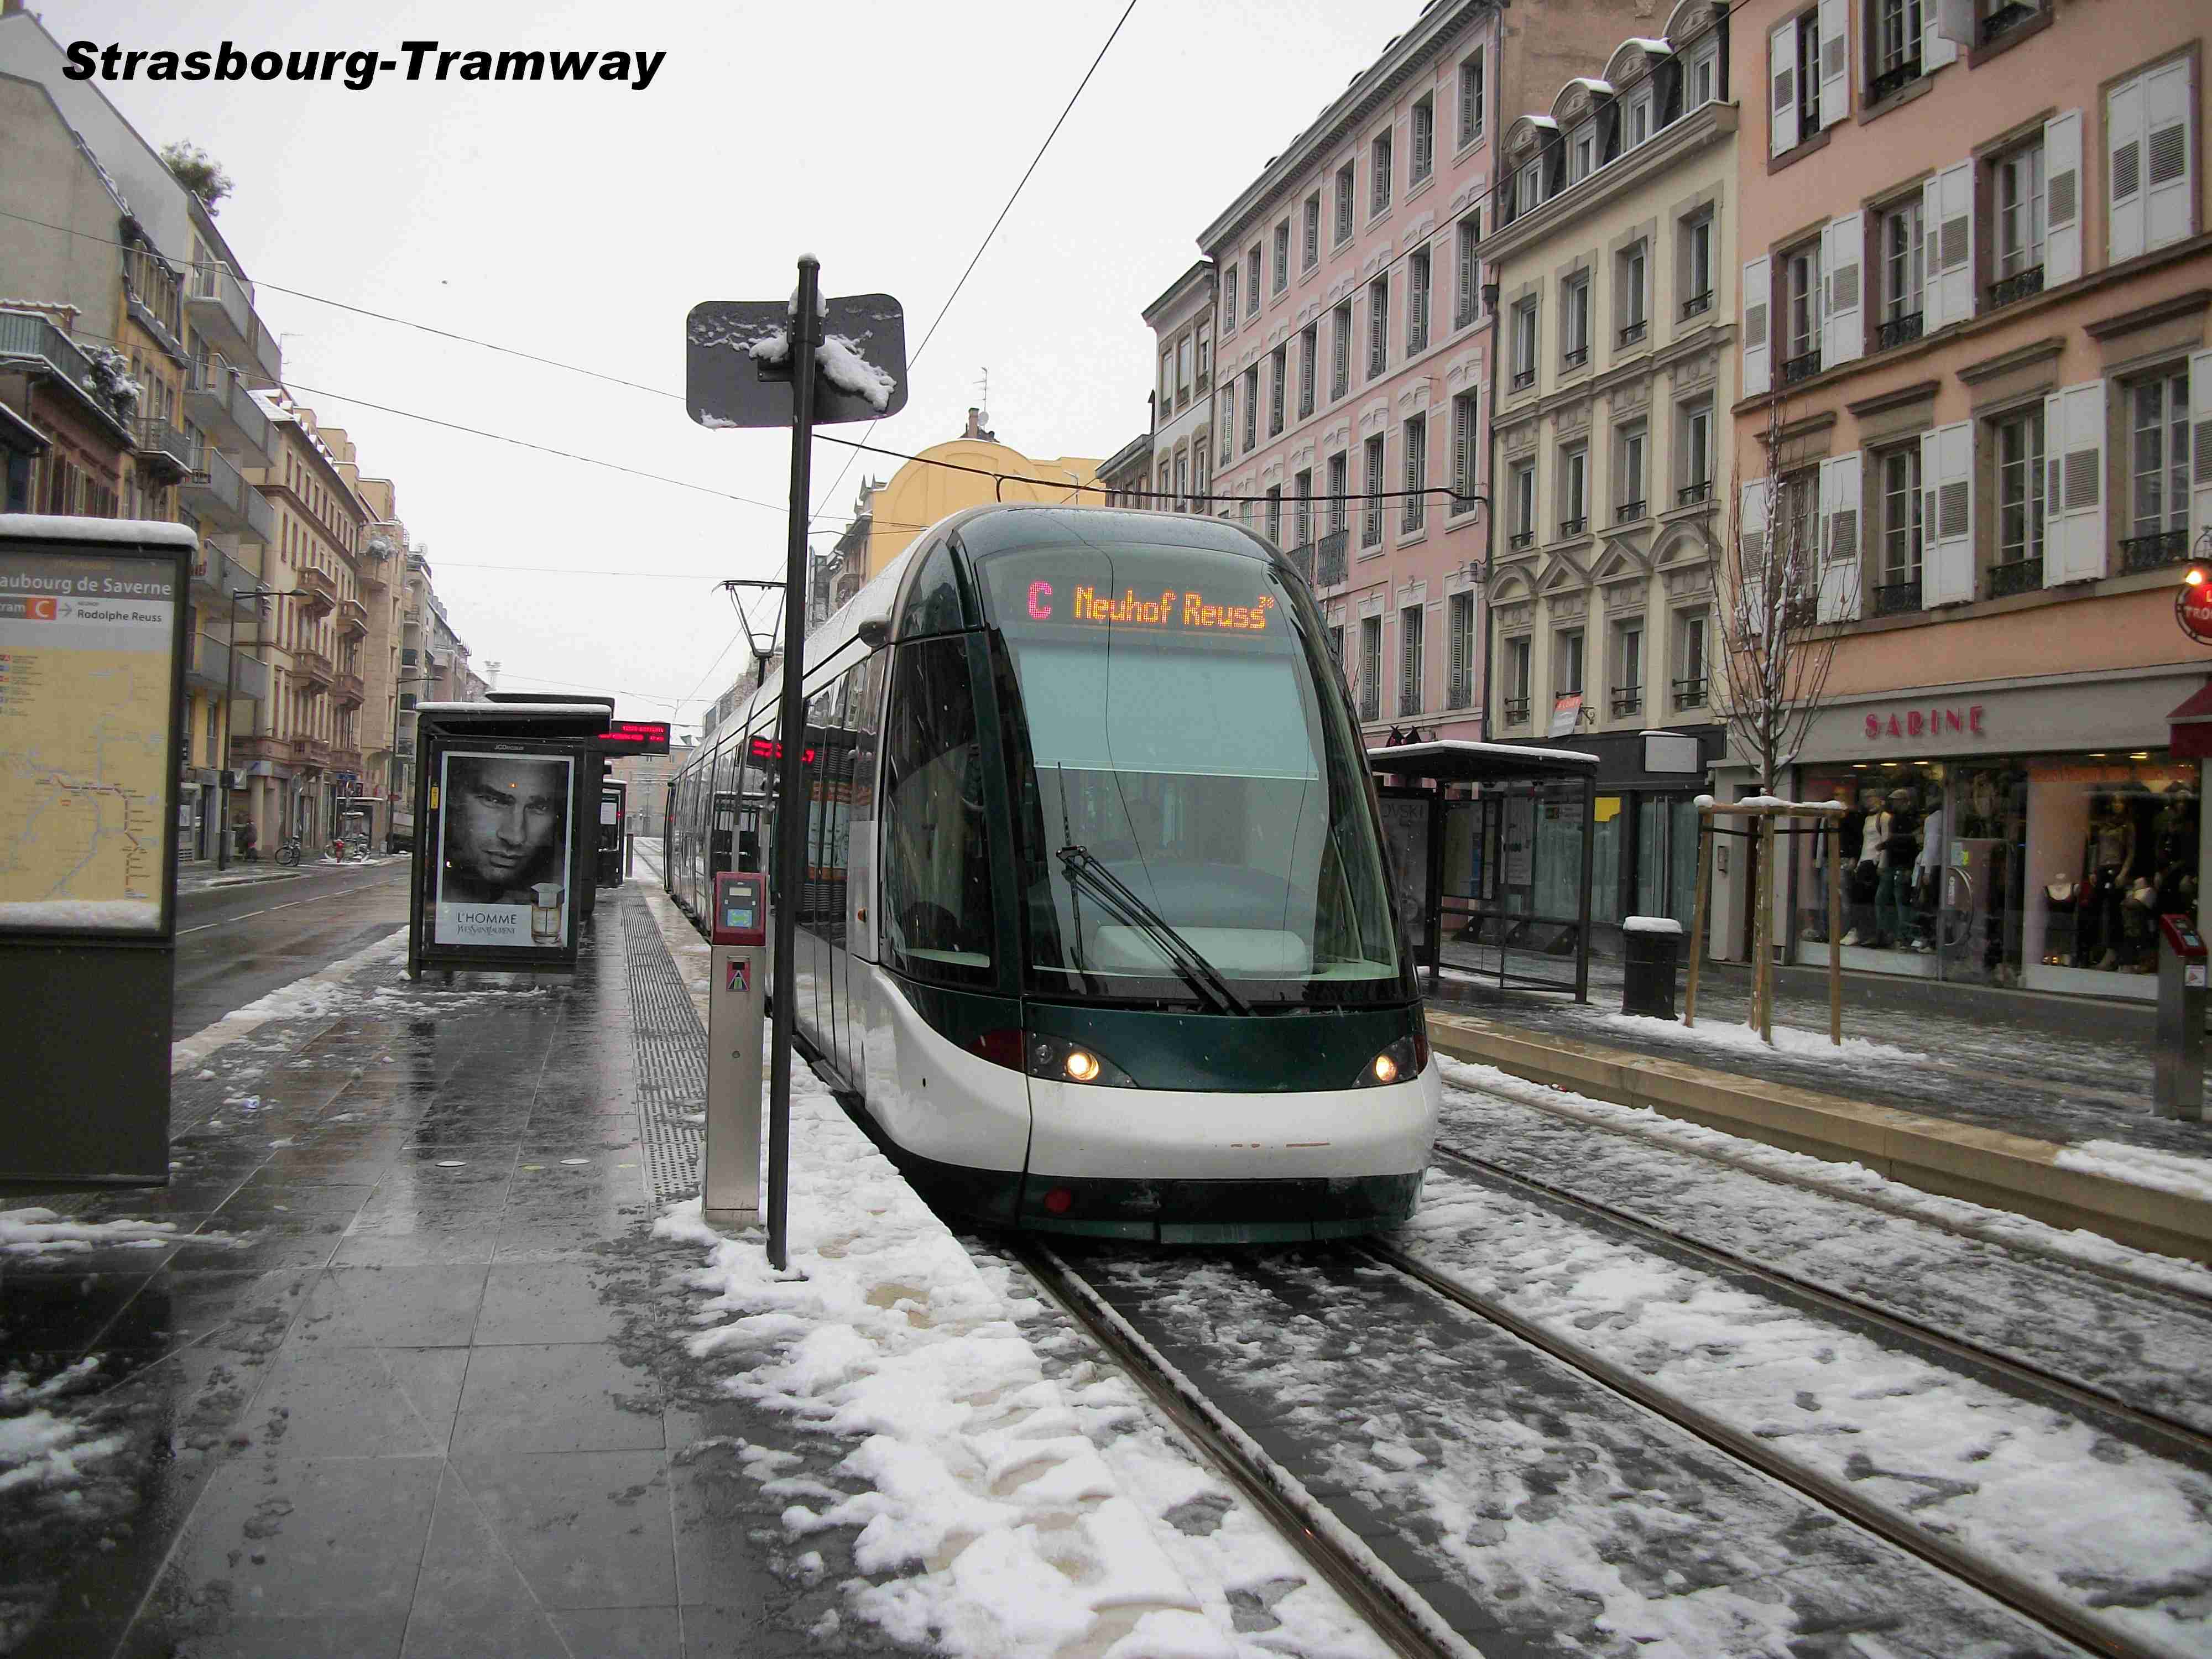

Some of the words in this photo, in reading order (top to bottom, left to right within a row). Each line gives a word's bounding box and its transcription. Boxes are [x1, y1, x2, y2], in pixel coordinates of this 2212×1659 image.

[77, 576, 98, 592] de
[103, 578, 172, 595] Saverne
[35, 600, 49, 618] C
[1029, 582, 1052, 620] C
[1074, 584, 1177, 624] Neuhof
[1183, 591, 1266, 629] Reuss
[77, 609, 129, 622] Rodolphe
[132, 611, 162, 623] Reuss
[457, 912, 518, 925] L'HOMME
